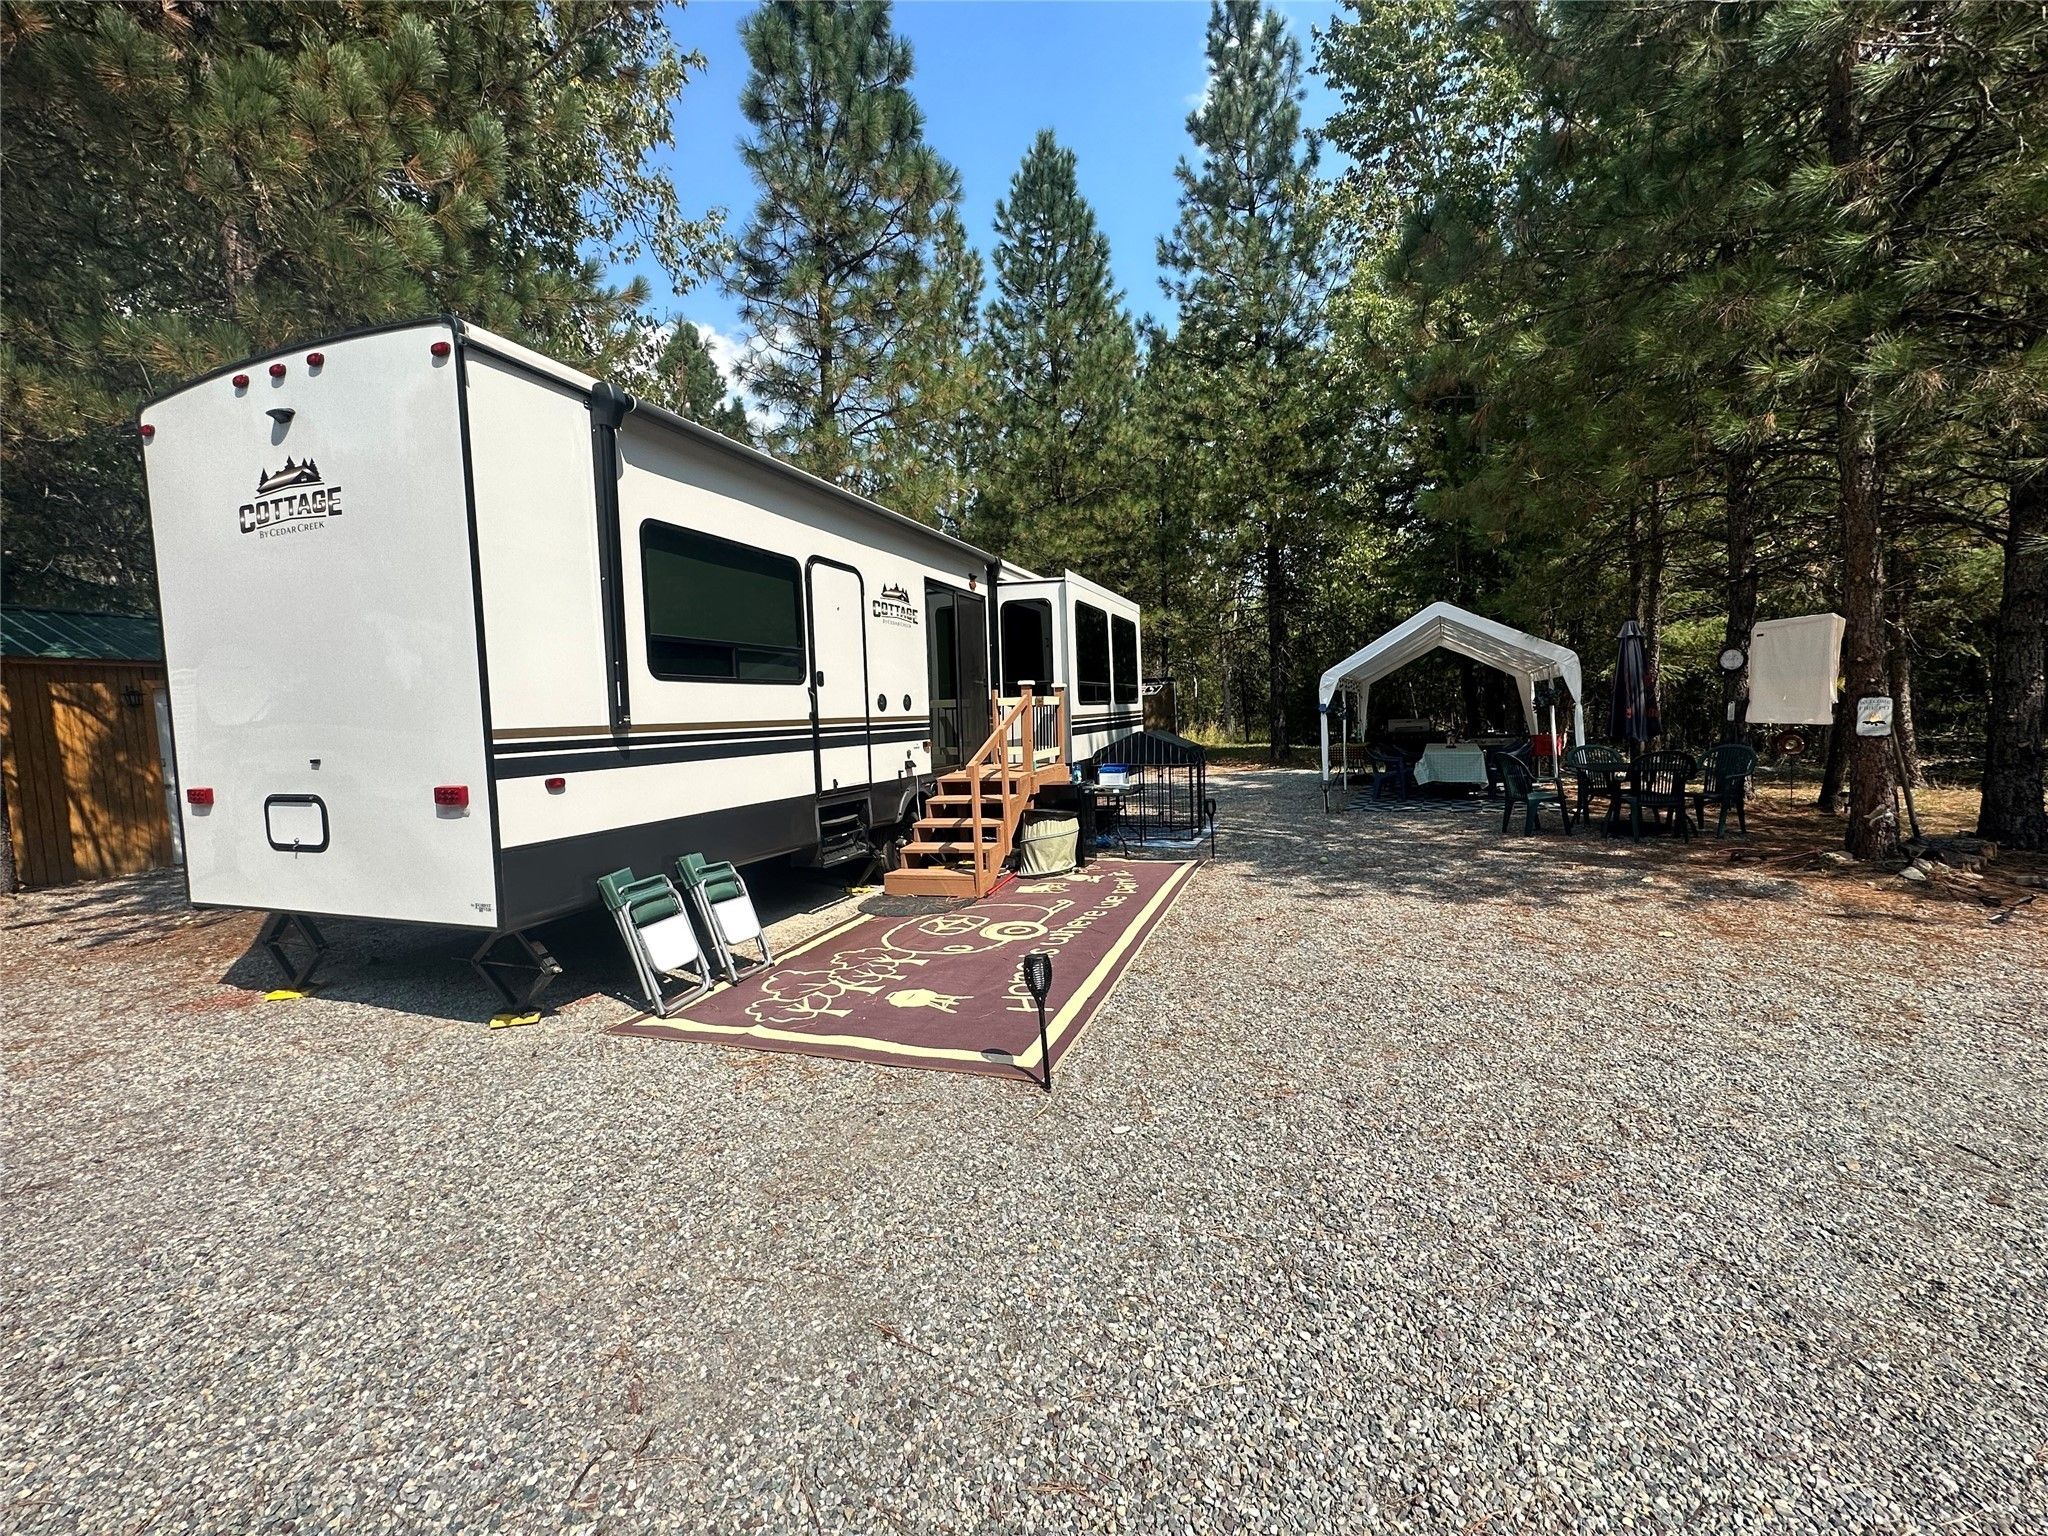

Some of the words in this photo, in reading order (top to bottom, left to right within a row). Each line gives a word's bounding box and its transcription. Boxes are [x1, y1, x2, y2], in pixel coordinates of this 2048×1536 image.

[239, 486, 342, 534] COTTAGE
[259, 530, 269, 539] BY
[269, 526, 297, 537] CEDAR
[297, 521, 325, 532] CREEK
[872, 599, 919, 625] COTTAGE
[1001, 961, 1055, 1012] Hom
[1040, 910, 1108, 946] where
[1093, 895, 1128, 909] we
